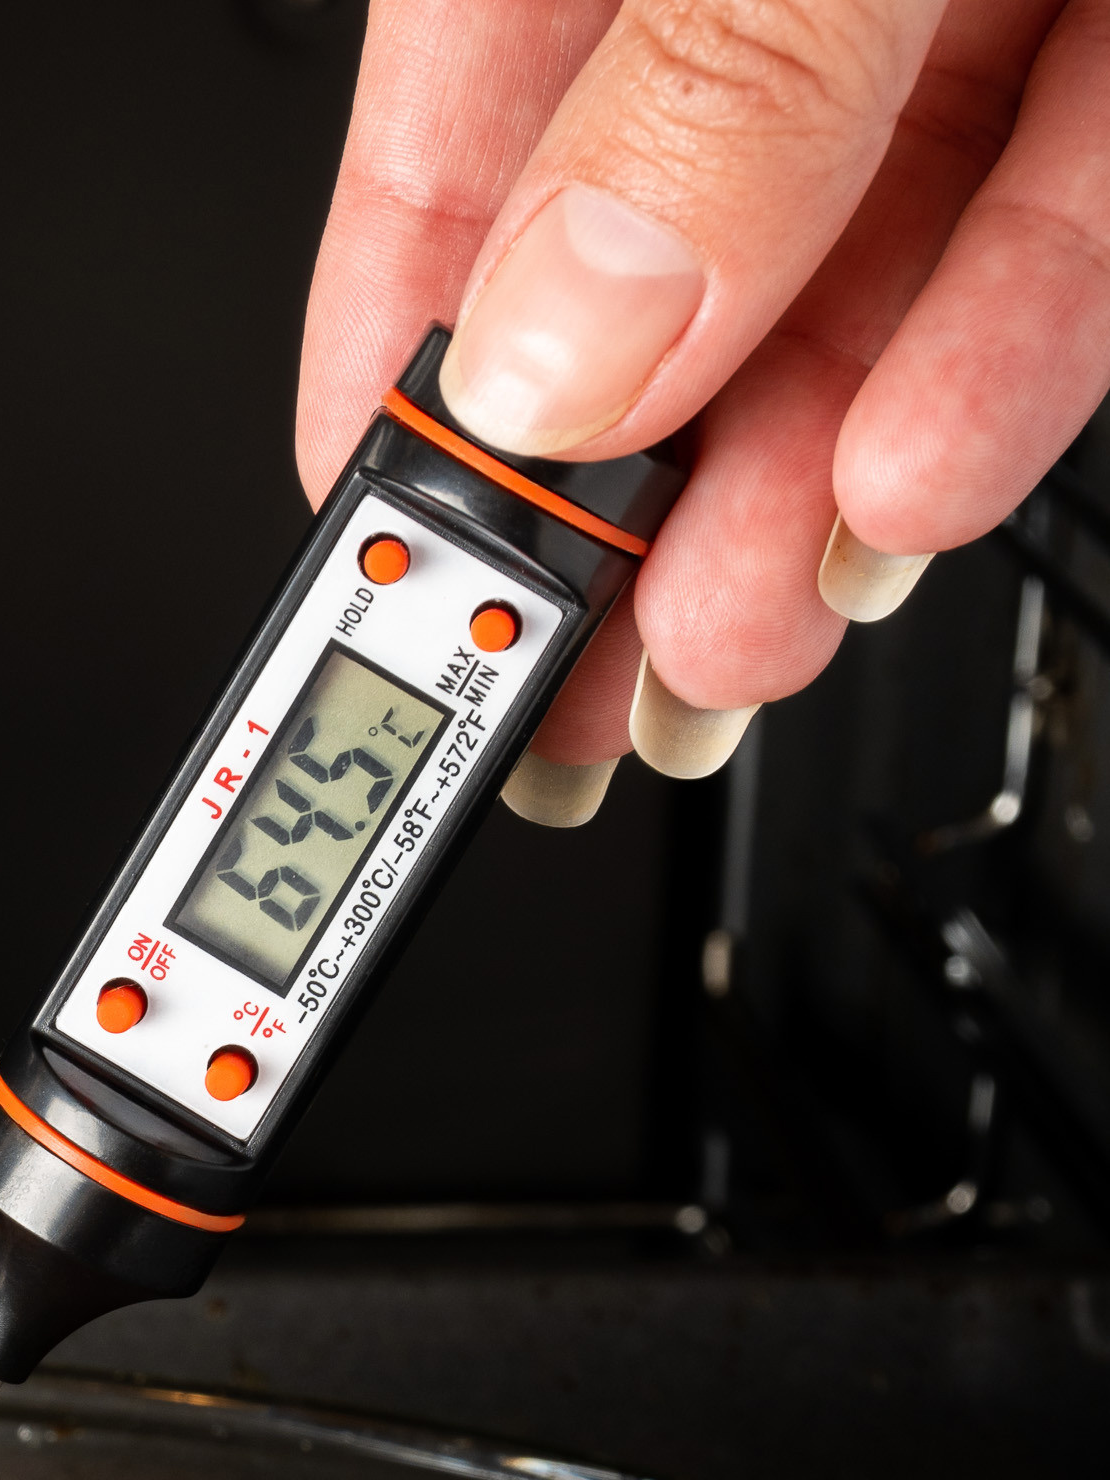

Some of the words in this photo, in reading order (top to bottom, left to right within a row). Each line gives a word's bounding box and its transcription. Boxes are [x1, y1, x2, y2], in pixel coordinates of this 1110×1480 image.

[335, 587, 375, 637] HOLD
[435, 646, 475, 695] MAX
[464, 664, 500, 707] MIN
[216, 716, 394, 932] 64.5
[127, 932, 153, 962] ON
[150, 943, 177, 981] OFF
[233, 1001, 260, 1021] °C
[262, 1018, 287, 1038] °F
